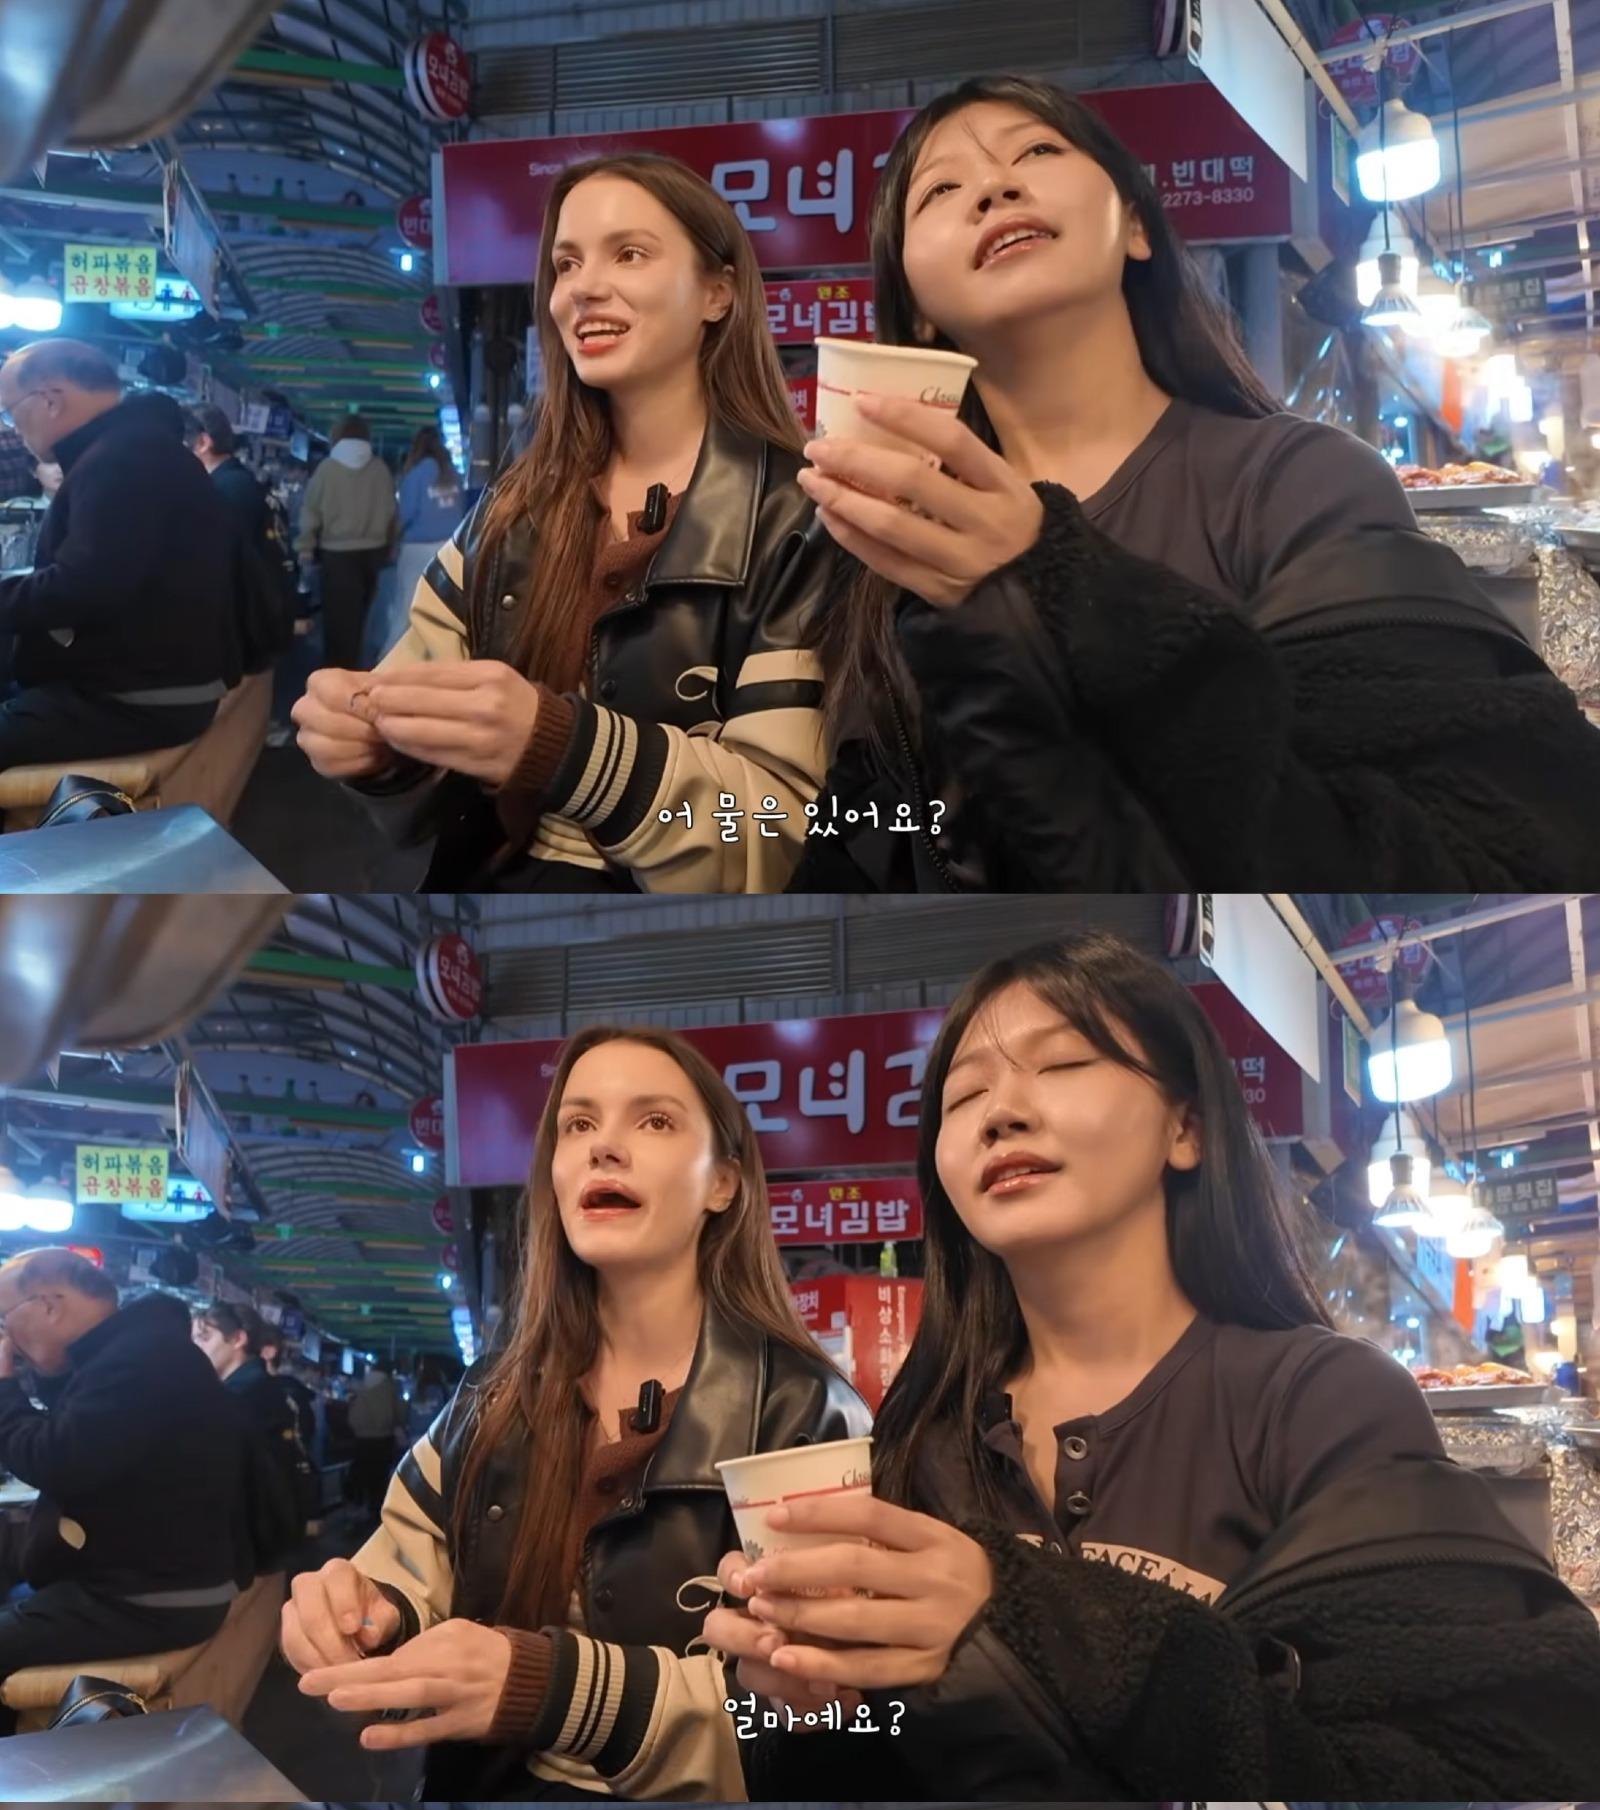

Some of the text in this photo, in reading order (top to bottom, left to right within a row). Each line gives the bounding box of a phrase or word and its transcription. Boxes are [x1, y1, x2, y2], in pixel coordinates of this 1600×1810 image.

[70, 252, 152, 275] 허파볶음
[71, 274, 152, 297] 곱창볶음
[82, 1151, 163, 1176] 허파볶음
[83, 1175, 163, 1199] 곱창볶음
[771, 1200, 909, 1237] 모녀김밥
